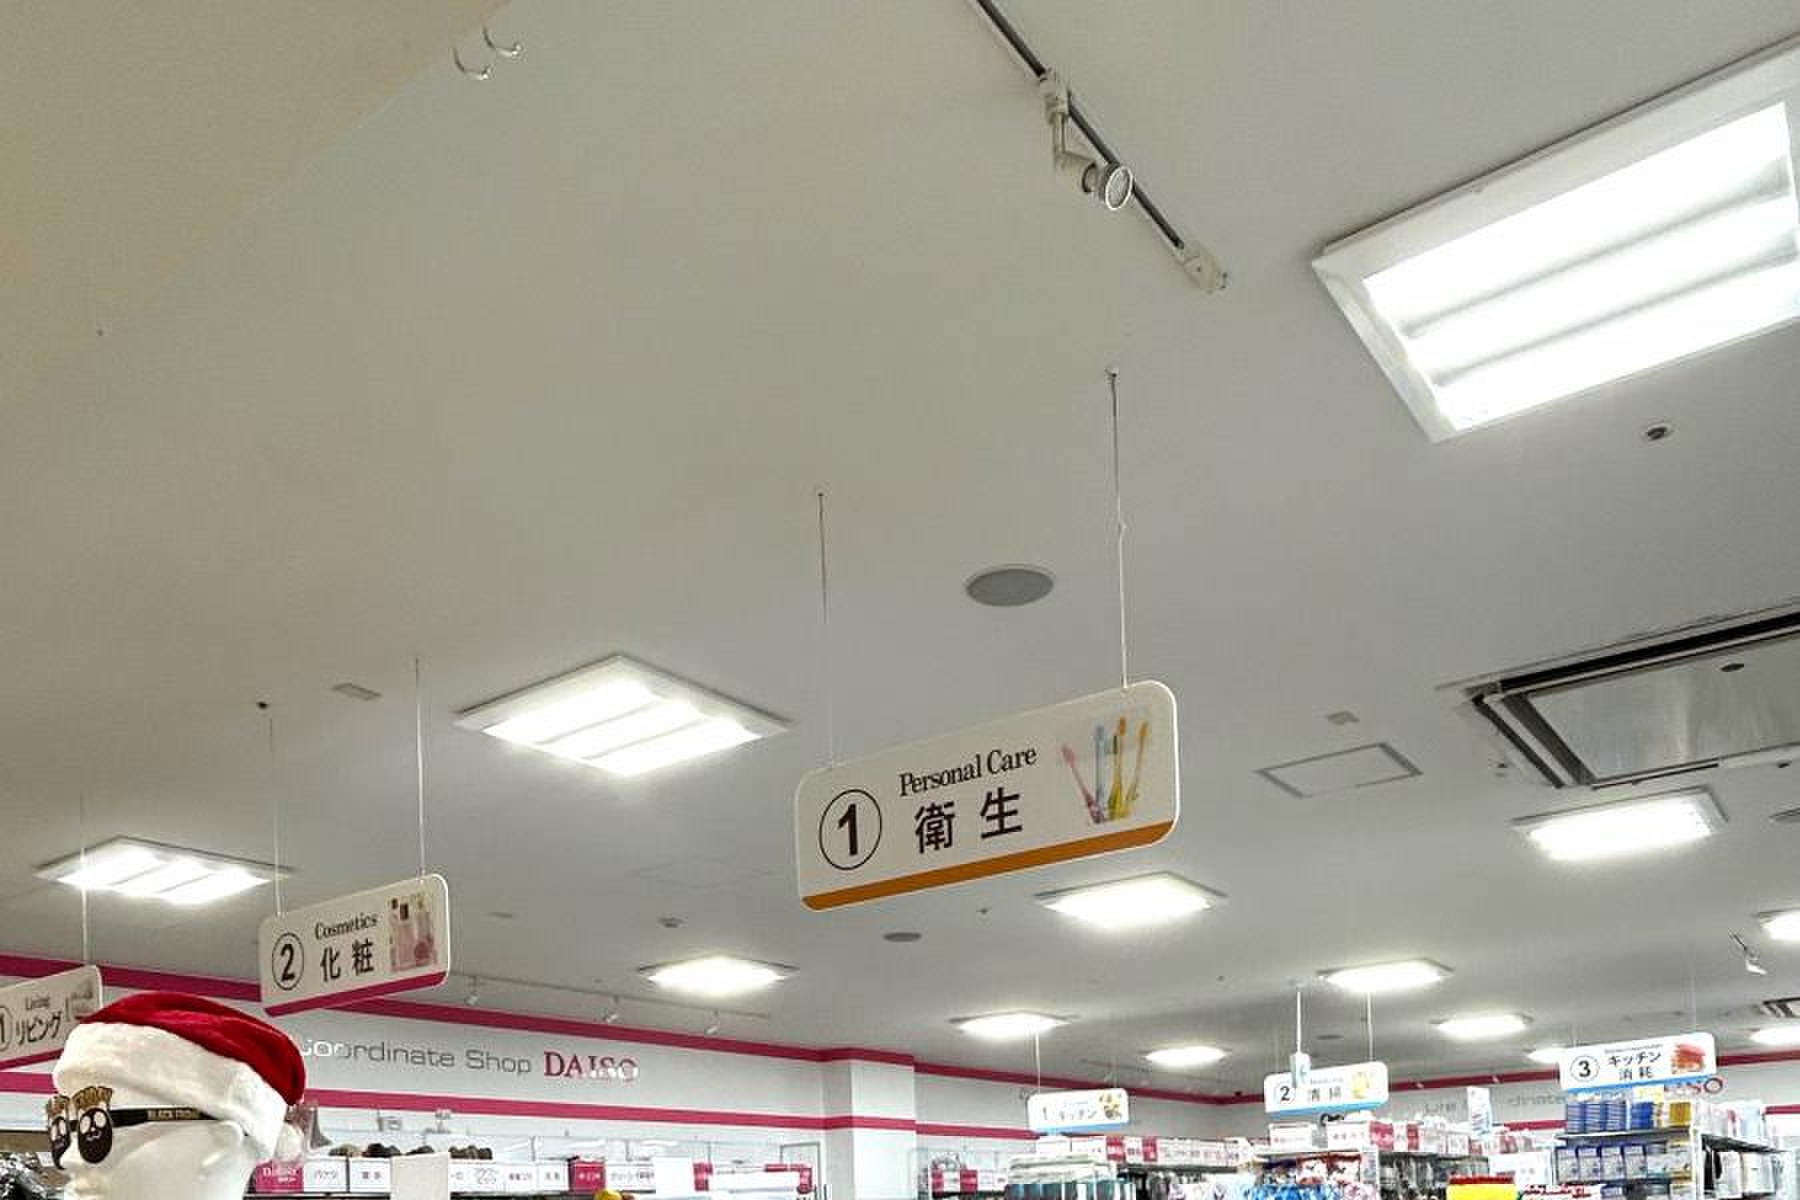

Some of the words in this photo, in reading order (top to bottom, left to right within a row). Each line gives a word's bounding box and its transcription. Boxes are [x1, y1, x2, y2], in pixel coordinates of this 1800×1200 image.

[899, 754, 982, 797] Personal
[987, 746, 1037, 775] Care
[915, 787, 1023, 854] 衛生
[314, 912, 378, 940] Cosmetics
[319, 940, 375, 982] 化粧
[15, 1010, 63, 1047] リビング
[464, 1048, 533, 1075] Shop
[543, 1050, 639, 1081] DAISO
